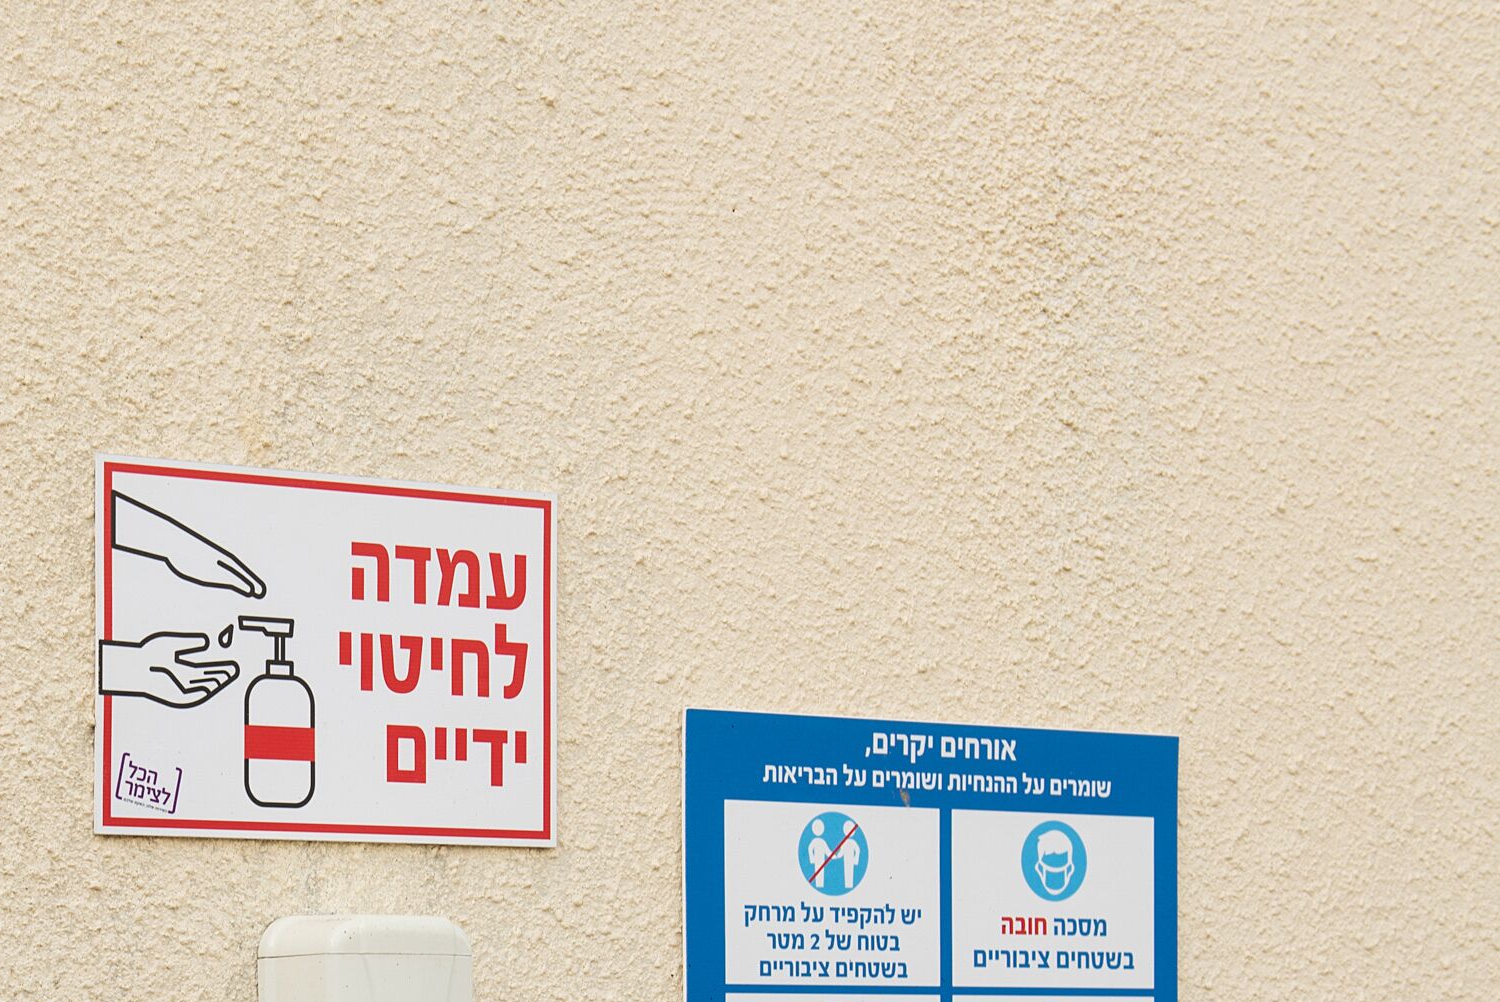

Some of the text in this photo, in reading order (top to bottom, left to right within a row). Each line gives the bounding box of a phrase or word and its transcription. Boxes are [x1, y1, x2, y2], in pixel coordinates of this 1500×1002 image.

[352, 542, 526, 610] עמדה
[340, 623, 528, 699] לחיטוי
[387, 725, 526, 786] ידיים
[866, 733, 1016, 763] אורחים יקרים,
[129, 760, 157, 785] הכל
[763, 764, 1111, 797] שומרים על ההנחיות ושומרים על הבריאות
[125, 780, 171, 805] לצימר
[744, 902, 921, 928] יש להקפיד על מרחק
[1002, 917, 1106, 936] מסכה חובה
[767, 929, 900, 951] בטוח של 2 מטר
[760, 961, 908, 978] בשטחים ציבוריים
[974, 950, 1134, 969] בשטחים ציבוריים
